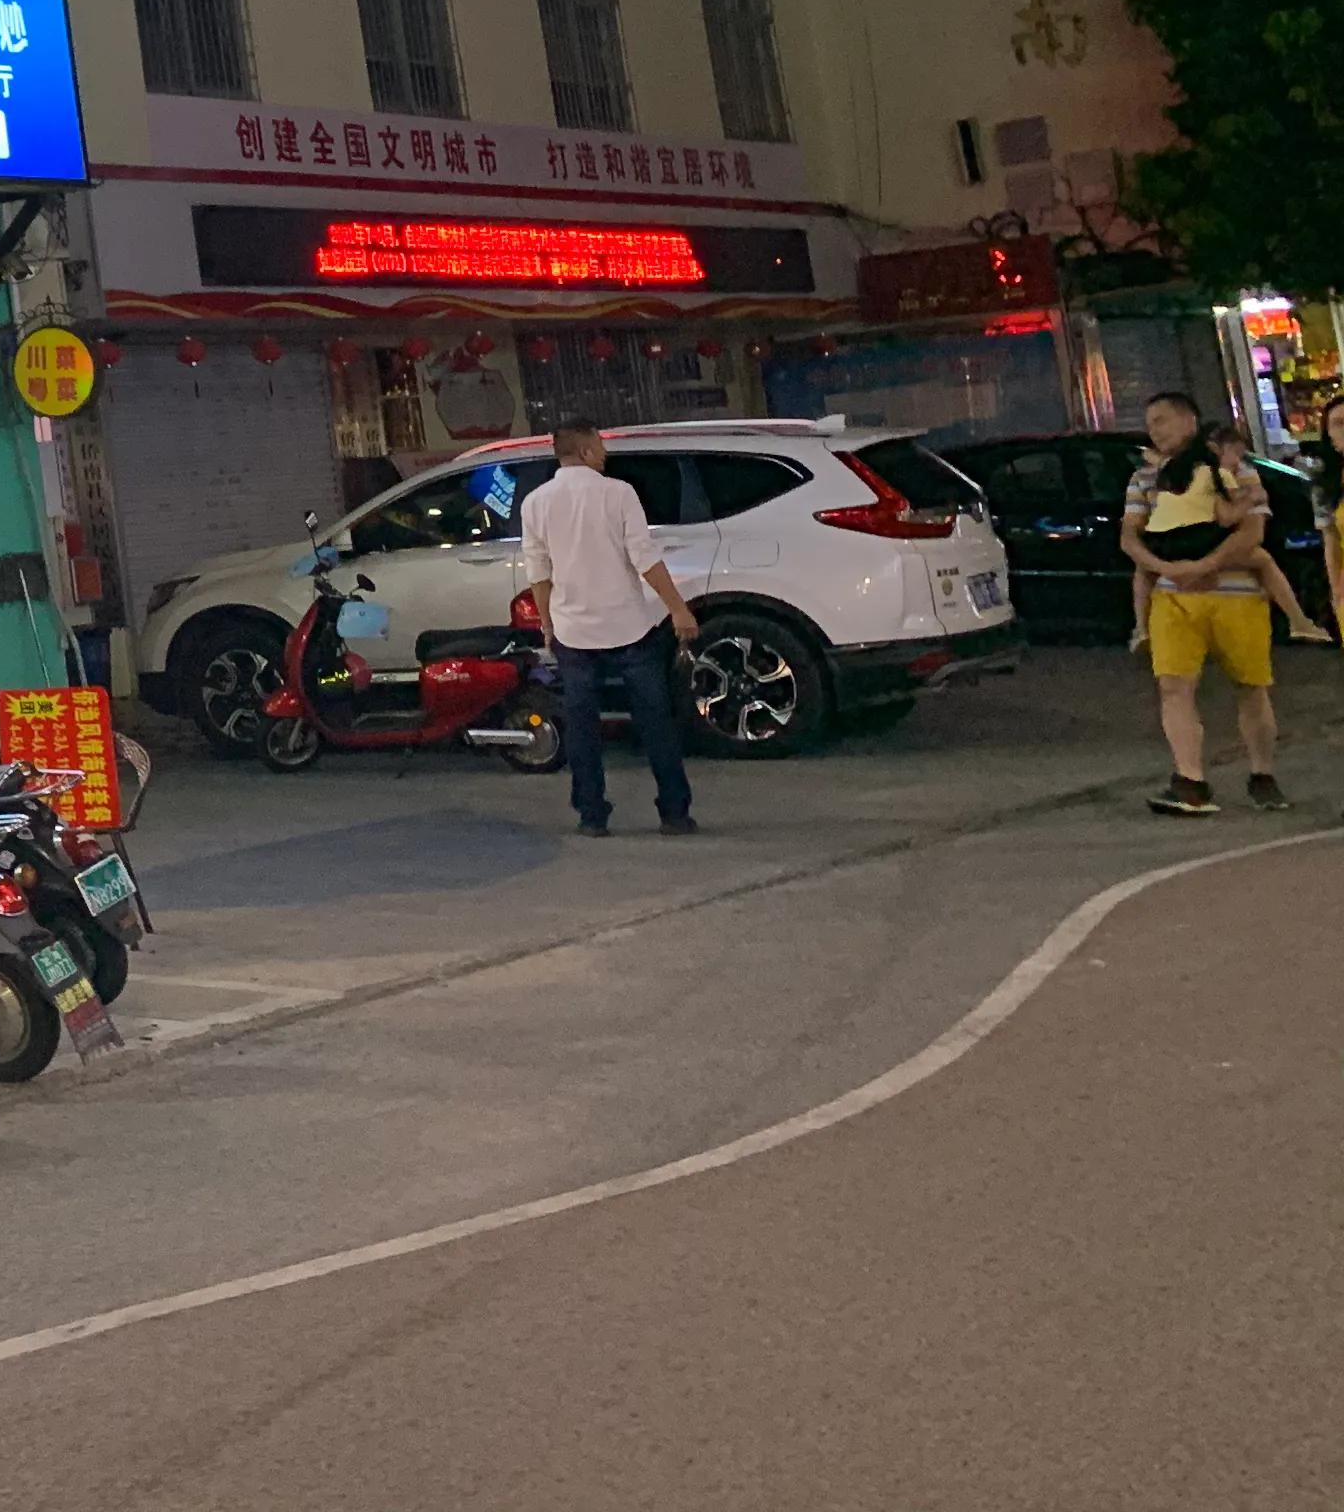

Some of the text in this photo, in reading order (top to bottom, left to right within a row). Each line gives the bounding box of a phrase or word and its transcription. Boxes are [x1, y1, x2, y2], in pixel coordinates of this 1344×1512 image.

[235, 114, 756, 189] 创建全国文明城市 打造和谐宜居环境
